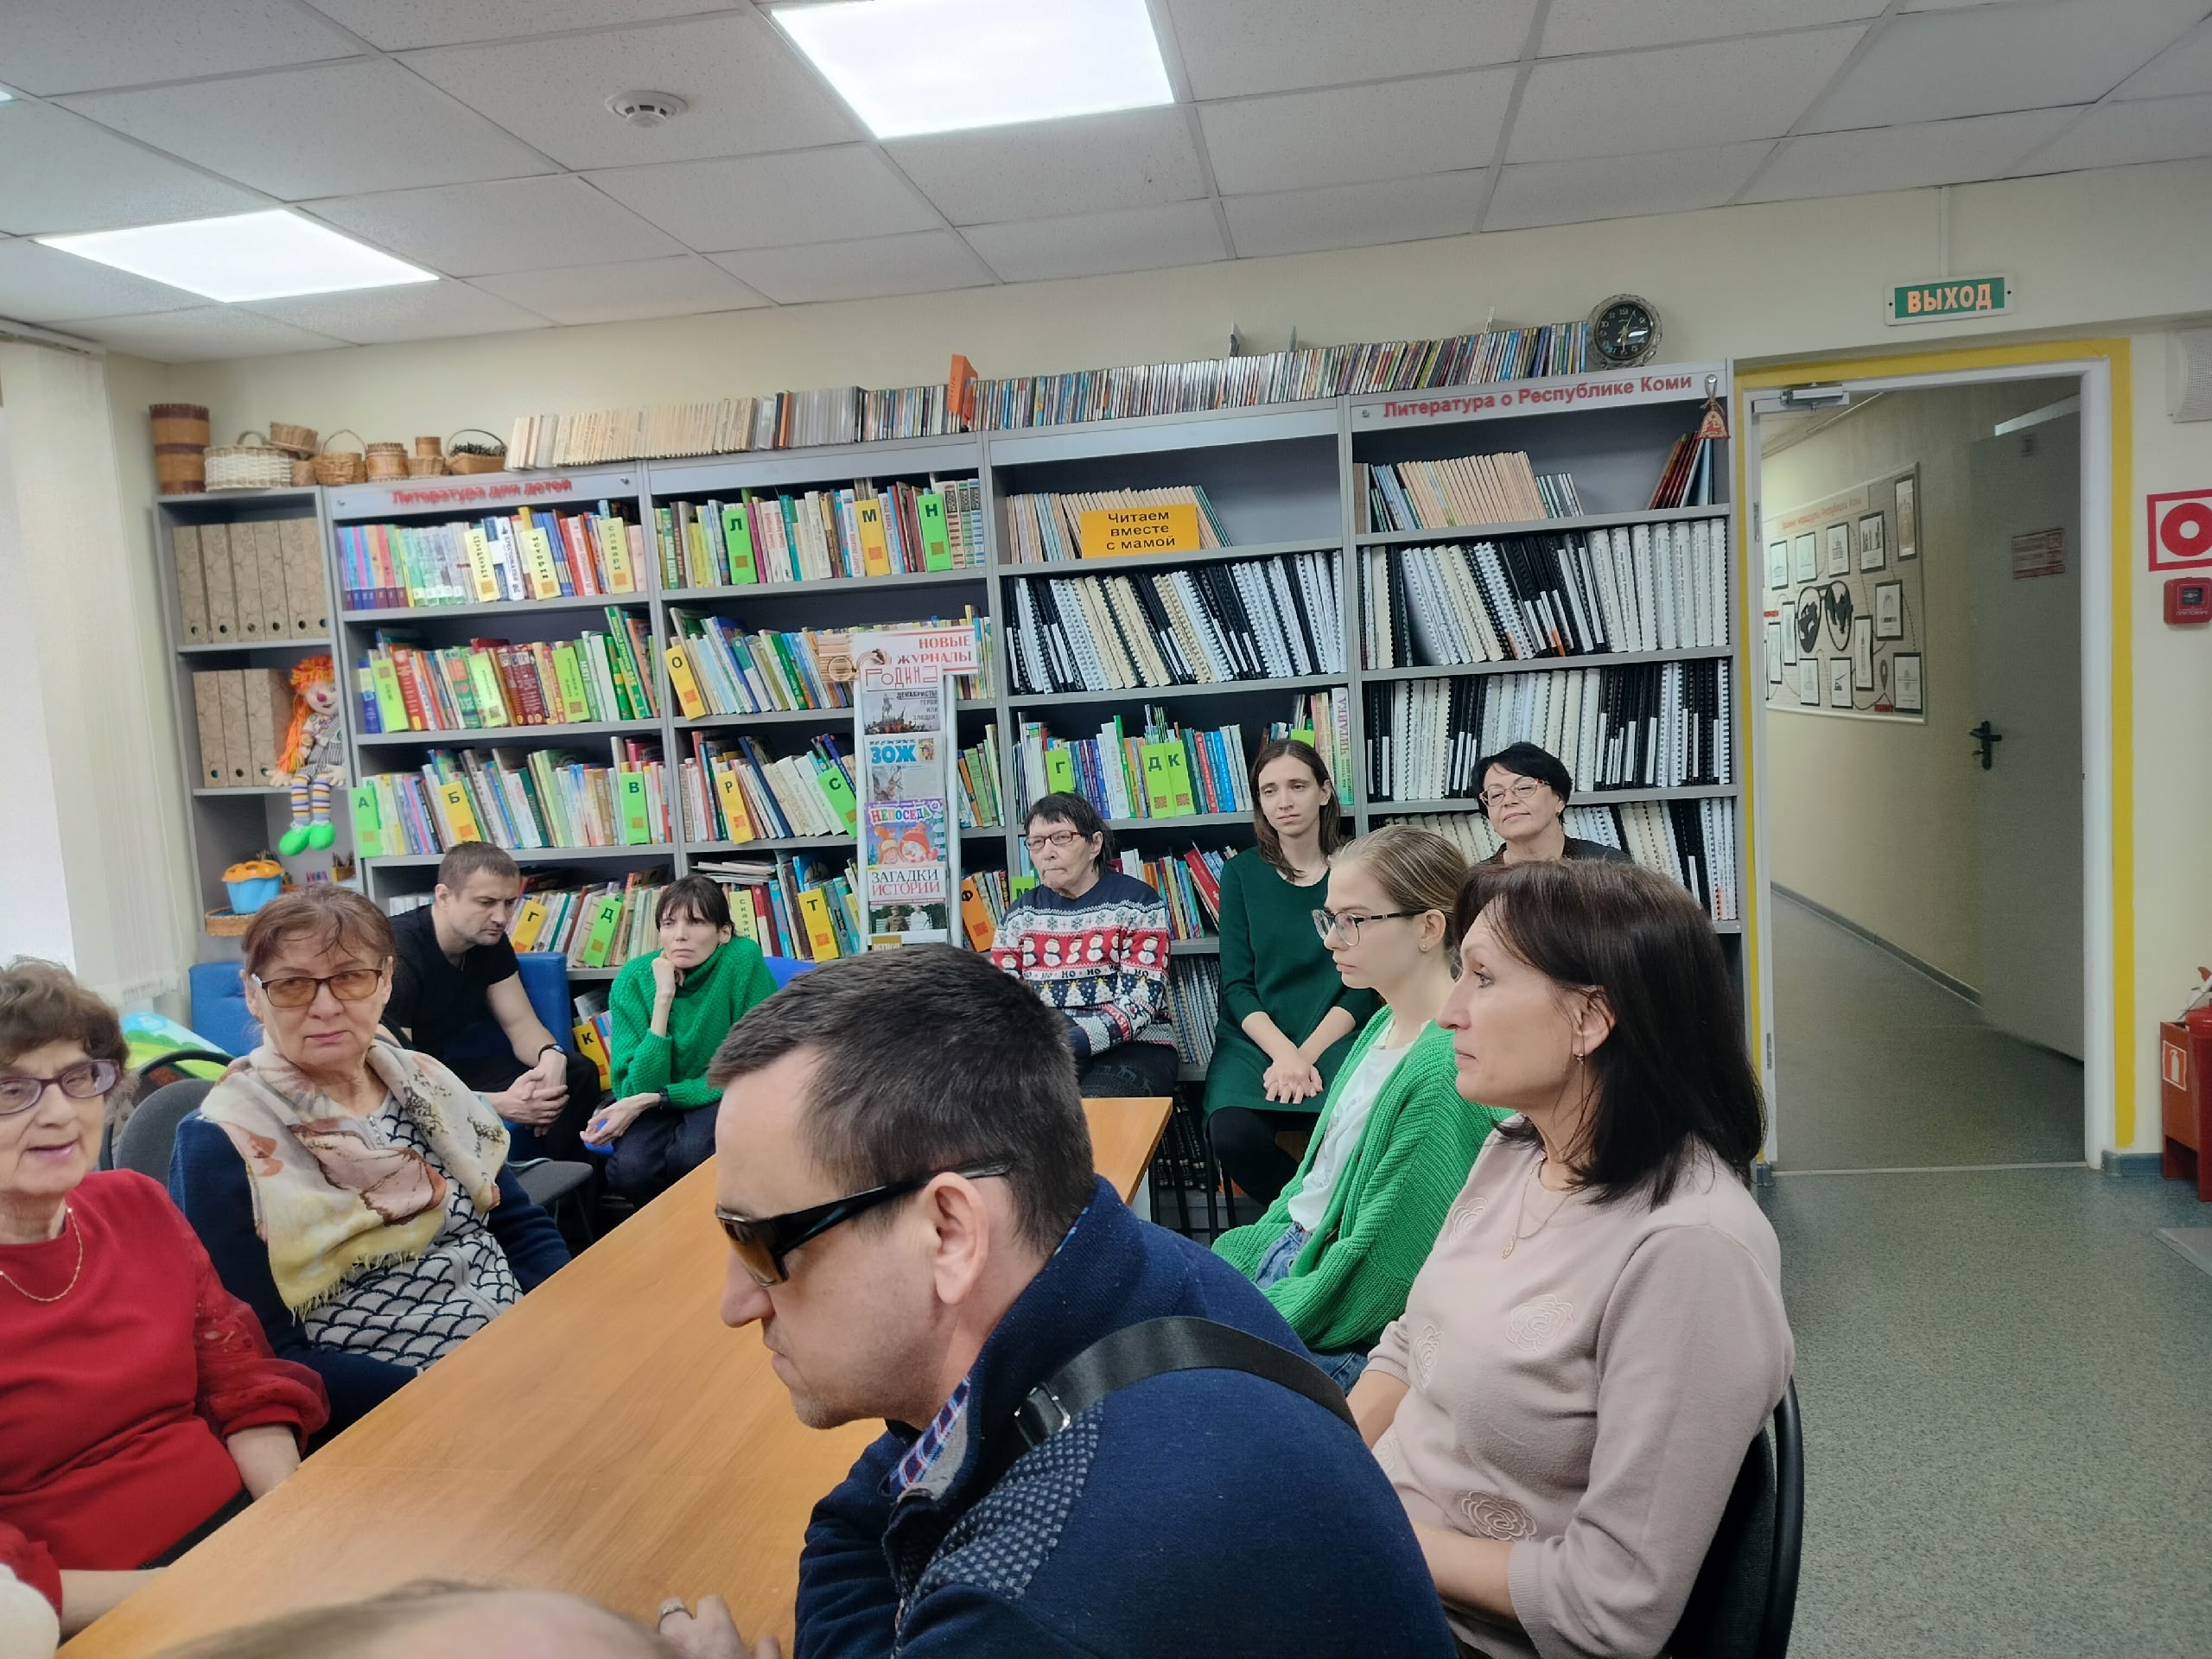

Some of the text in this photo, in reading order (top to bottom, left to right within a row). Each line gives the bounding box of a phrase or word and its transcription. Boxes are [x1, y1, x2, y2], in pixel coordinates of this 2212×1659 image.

[1907, 283, 1992, 314] ВЫХОД
[1383, 376, 1693, 420] Литература о Республике Коми
[392, 478, 572, 505] Литература для детей
[862, 509, 877, 523] М
[925, 504, 938, 518] Н
[1108, 512, 1170, 524] Читаем
[729, 518, 743, 531] Л
[1110, 524, 1169, 537] вместе
[1106, 535, 1175, 550] с мамой
[918, 635, 971, 649] НОВЫЕ
[671, 656, 683, 669] О
[897, 651, 971, 664] ЖУРНАЛЫ
[896, 690, 938, 699] ДЕКАБРИСТЫ
[1338, 696, 1350, 756] ЧИТАЙКА
[870, 745, 917, 764] ЗОЖ
[1167, 753, 1180, 767] К
[1055, 760, 1065, 774] Г
[1148, 756, 1162, 772] Д
[628, 781, 639, 794] В
[724, 780, 733, 793] Р
[829, 778, 842, 791] С
[358, 797, 369, 809] А
[448, 791, 460, 804] Б
[870, 806, 932, 823] НЕПОСЕДА
[871, 868, 938, 884] ЗАГАДКИ
[872, 881, 940, 896] ИСТОРИИ
[962, 890, 973, 902] Ф
[806, 899, 818, 912] Т
[527, 911, 539, 922] Г
[601, 907, 614, 924] Д
[582, 1032, 594, 1046] К
